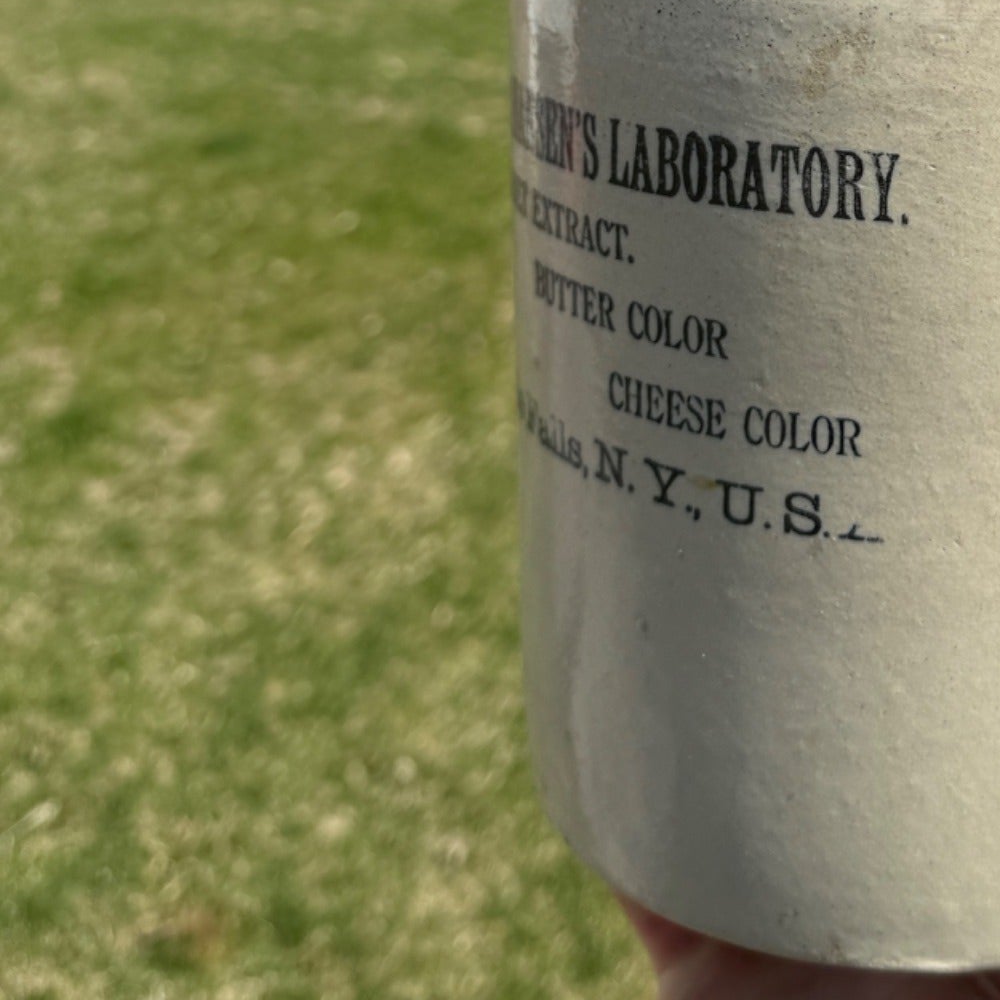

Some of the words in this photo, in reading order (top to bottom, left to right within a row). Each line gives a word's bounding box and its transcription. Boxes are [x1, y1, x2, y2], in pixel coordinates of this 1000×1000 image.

[608, 117, 909, 226] LABORATORY.
[532, 187, 635, 265] EXTRACT.
[534, 259, 616, 332] BUTTER
[627, 300, 729, 360] COLOR
[608, 371, 727, 440] CHEESE
[743, 405, 862, 457] COLOR
